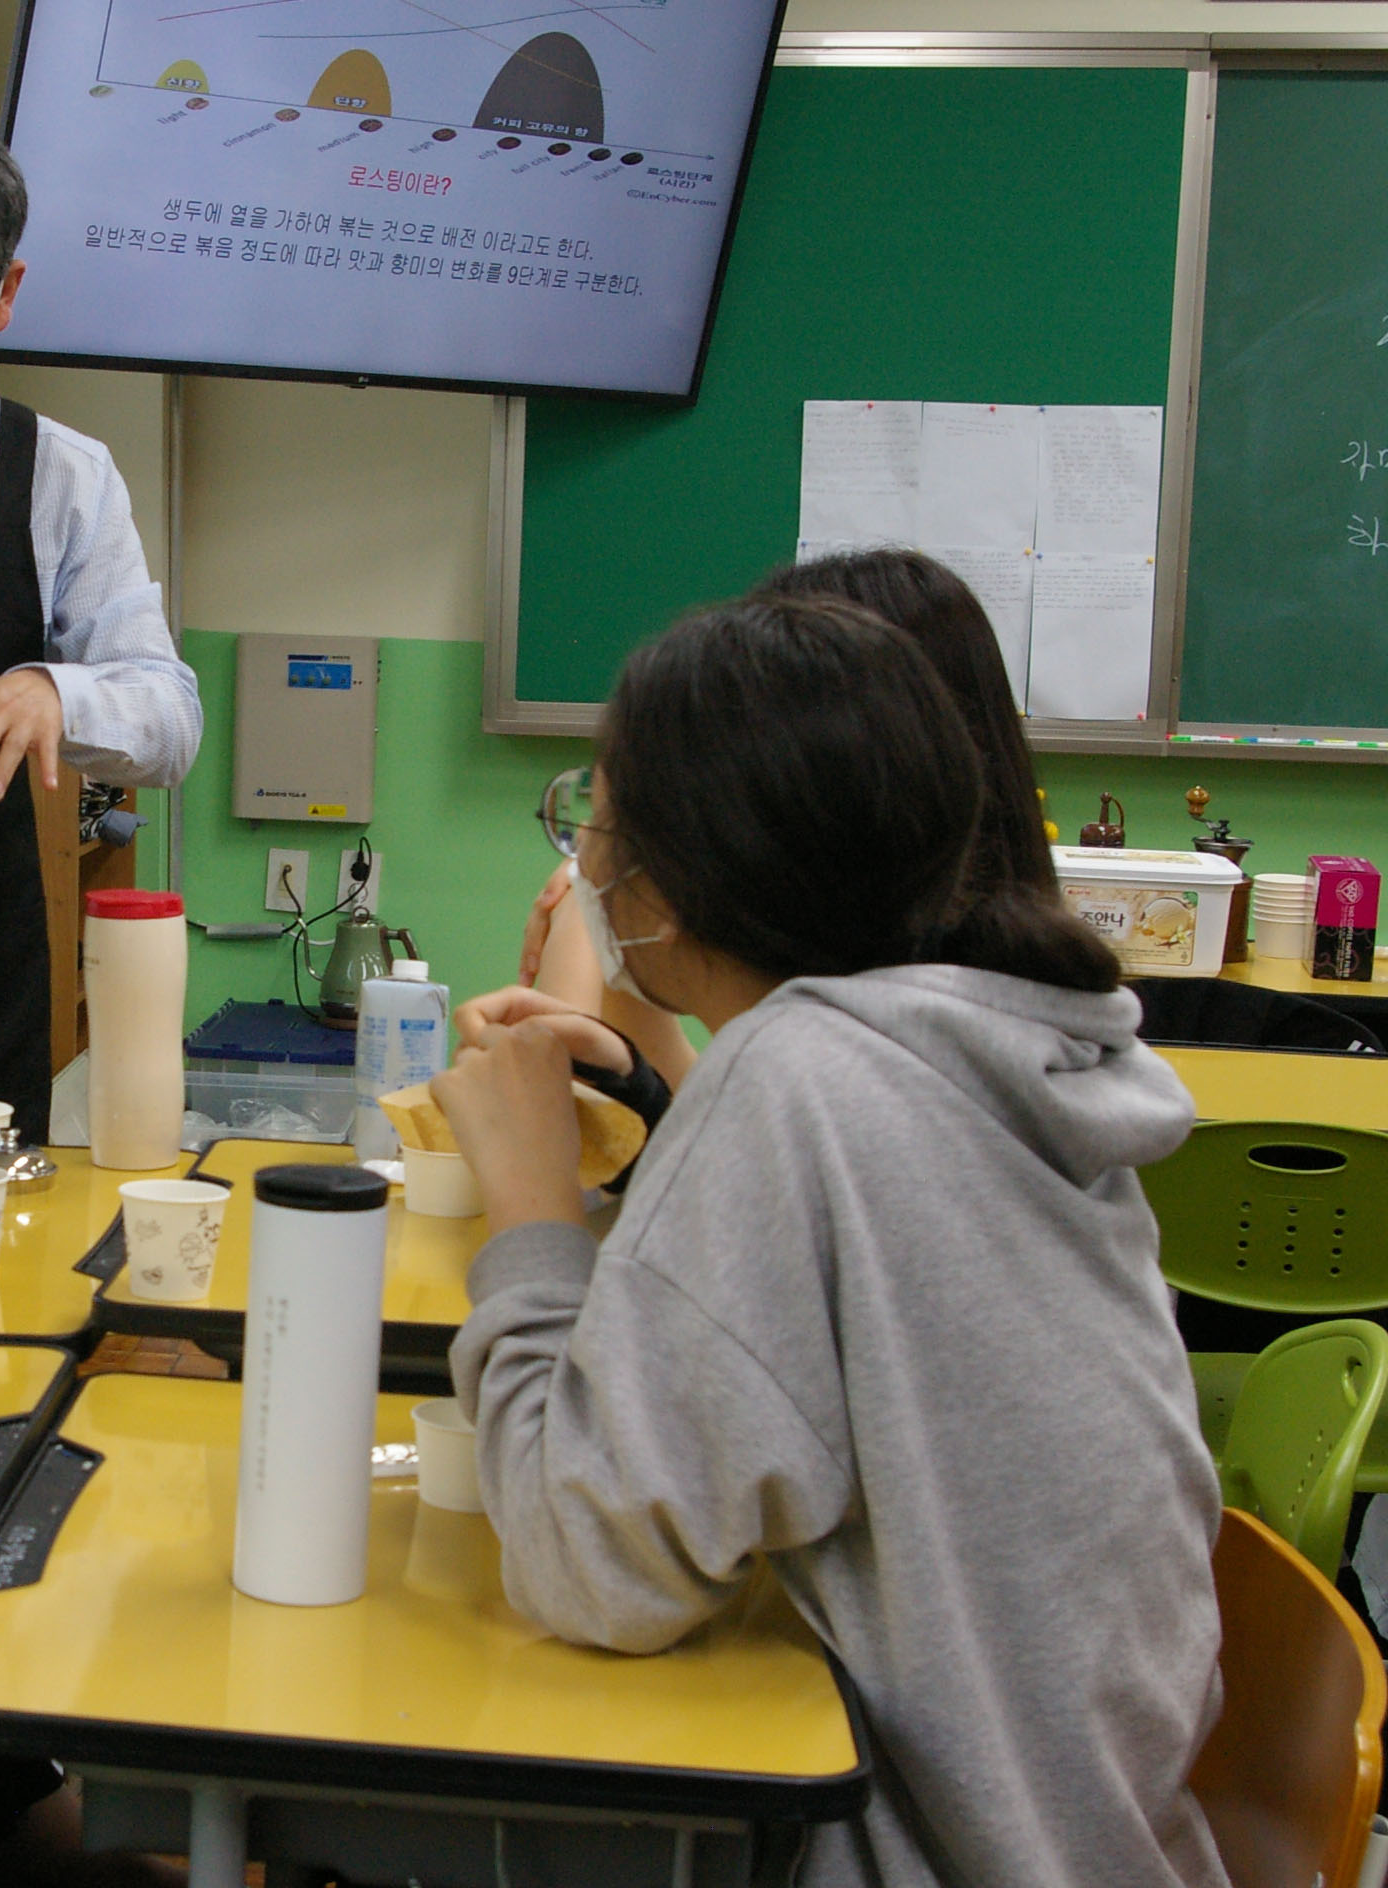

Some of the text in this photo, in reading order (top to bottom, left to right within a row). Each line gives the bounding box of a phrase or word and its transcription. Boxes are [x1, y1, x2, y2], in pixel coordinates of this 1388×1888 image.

[348, 165, 452, 197] 로스팅이란?
[84, 224, 644, 297] 일반적으로 볶음 정도에 따라 맛과 향미의 변화를 9단계로 구분한다.
[163, 198, 594, 262] 생두에 열을 가하여 볶는 것으로 배전 이라고도 한다.
